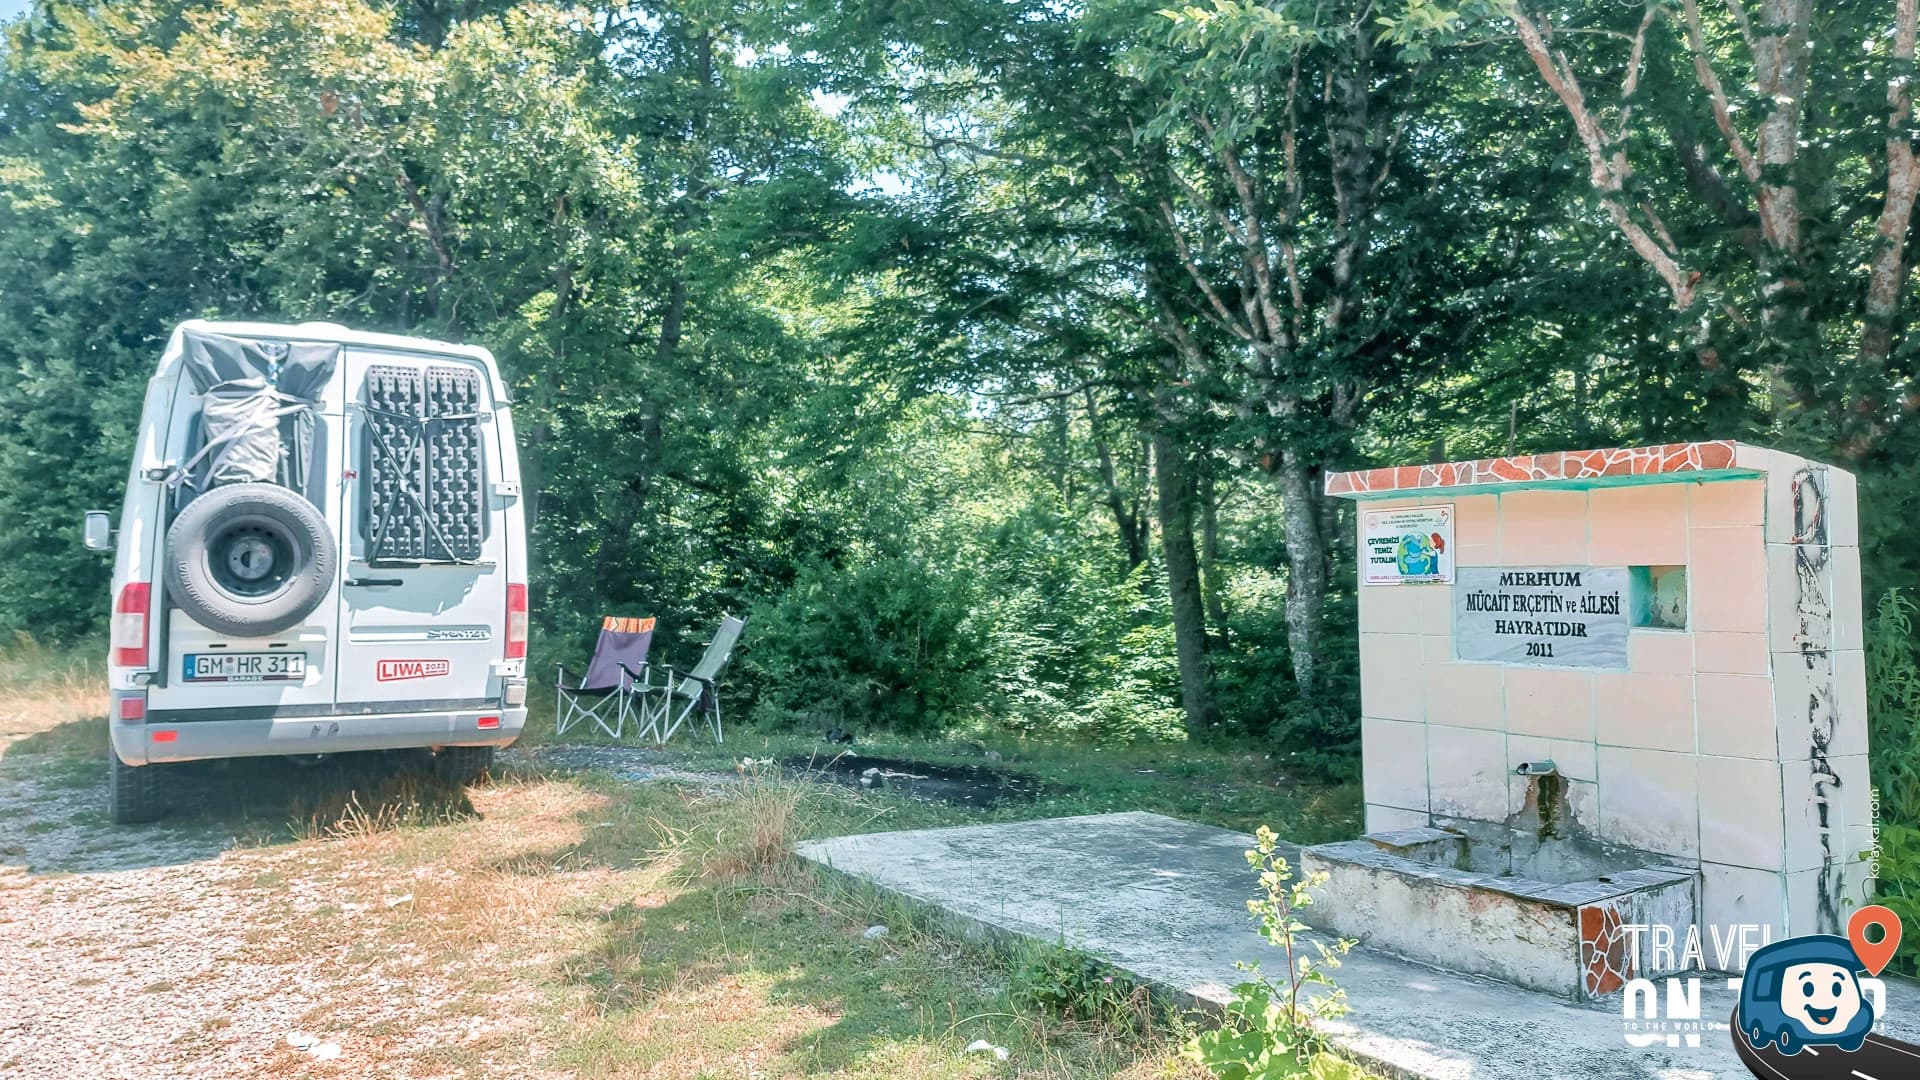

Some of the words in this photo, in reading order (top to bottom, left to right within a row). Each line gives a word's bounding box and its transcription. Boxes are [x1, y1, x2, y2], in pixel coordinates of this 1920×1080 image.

[1374, 546, 1393, 554] TEMİZ
[1370, 556, 1397, 565] TUTALIM
[1499, 572, 1582, 587] MERHUM
[1466, 589, 1511, 612] MÜCAİT
[1512, 590, 1563, 617] ERÇETİN
[1566, 600, 1577, 613] ve
[1579, 590, 1620, 615] AİLESİ
[1494, 619, 1588, 638] HAYRATIDIR
[1526, 642, 1554, 658] 2011
[197, 657, 223, 674] GM
[237, 656, 262, 673] HR
[267, 656, 302, 673] 311
[382, 662, 425, 678] LIWA
